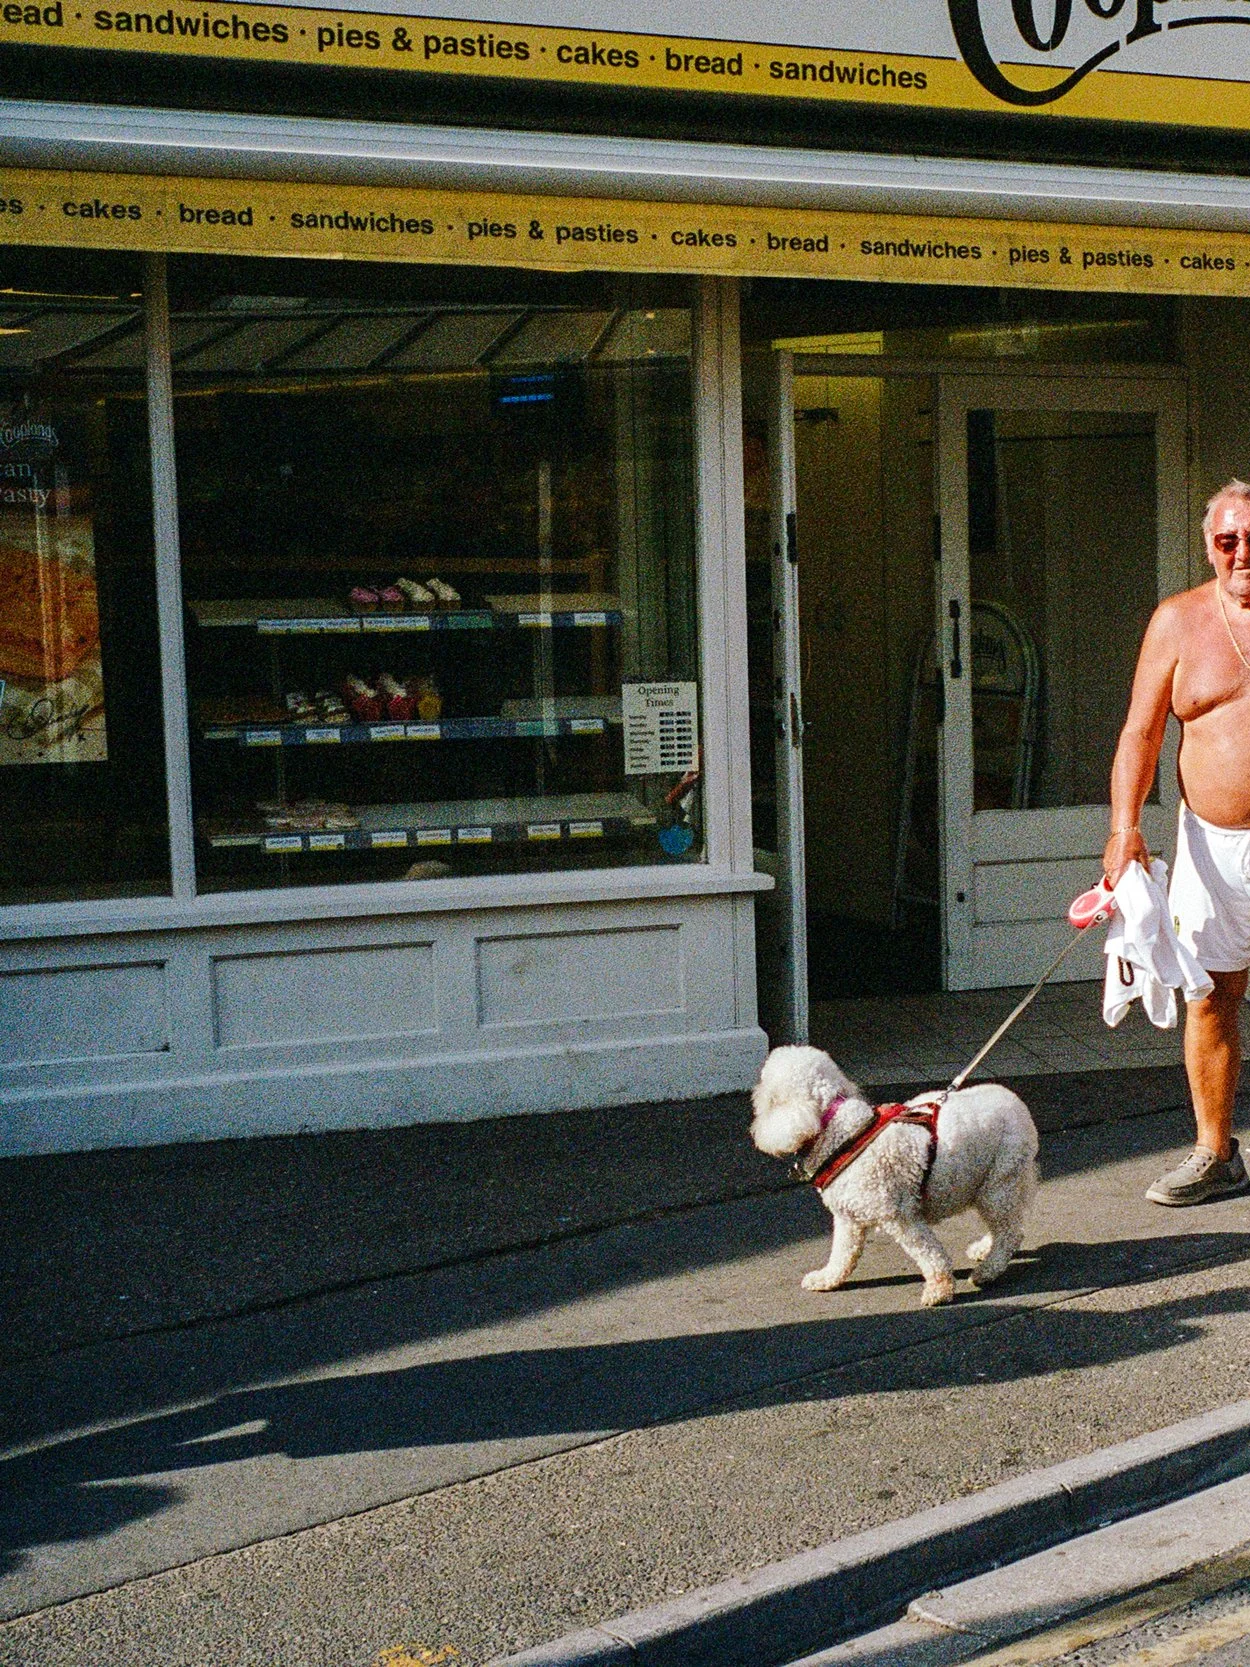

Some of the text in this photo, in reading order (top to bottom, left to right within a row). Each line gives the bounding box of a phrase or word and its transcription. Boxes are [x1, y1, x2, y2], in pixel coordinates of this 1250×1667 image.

[0, 1, 928, 90] ead sandwiches pies & pasties cakes bread sandwiches
[62, 200, 142, 220] cakes
[179, 203, 253, 226] bread
[290, 208, 434, 235] sandwiches
[467, 218, 518, 241] pies
[528, 220, 545, 241] &
[556, 223, 639, 245] pasties
[671, 228, 738, 248] cakes
[767, 231, 829, 253] bread
[860, 237, 983, 261] sandwiches
[1008, 245, 1050, 266] pies
[1059, 247, 1072, 265] &
[1082, 249, 1154, 271] pasties
[1179, 252, 1236, 272] cakes
[0, 487, 52, 508] asty
[637, 684, 680, 701] Opening
